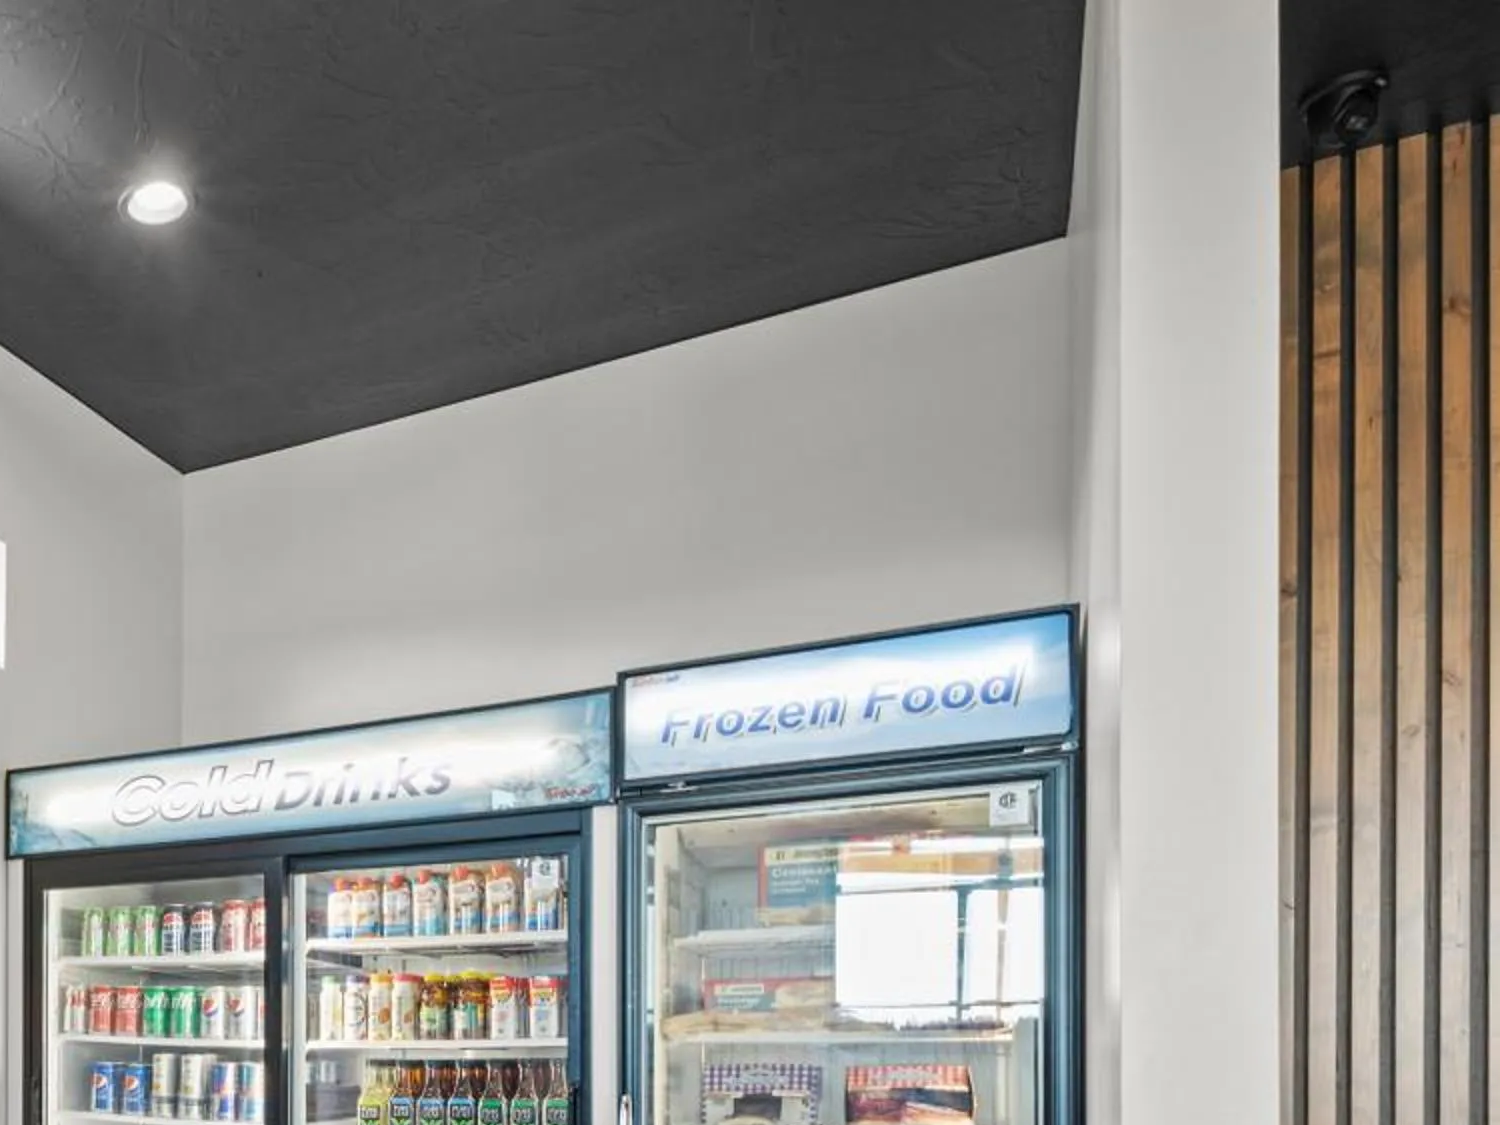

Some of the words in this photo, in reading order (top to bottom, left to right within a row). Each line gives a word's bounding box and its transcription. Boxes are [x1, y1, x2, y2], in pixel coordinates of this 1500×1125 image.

[660, 691, 847, 747] Frozen
[862, 662, 1027, 723] Food
[111, 759, 275, 826] Cold
[274, 756, 453, 810] Drinks
